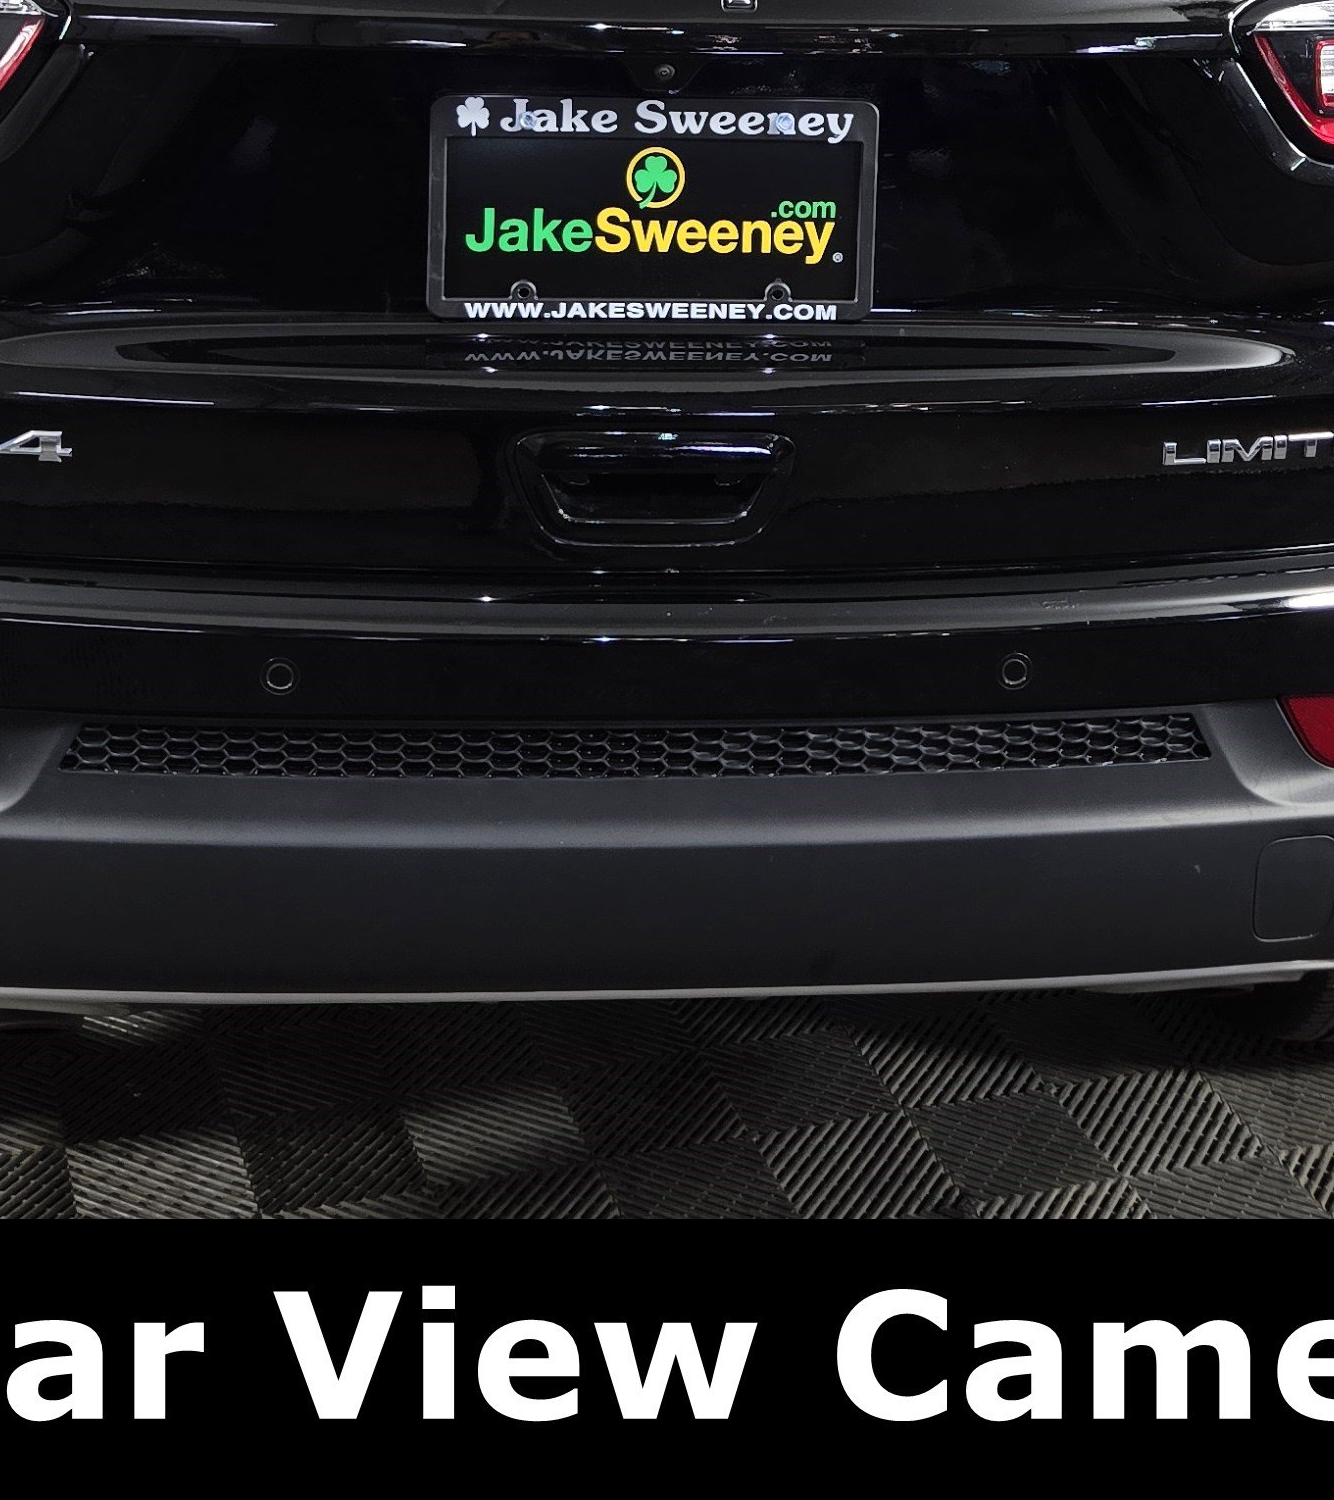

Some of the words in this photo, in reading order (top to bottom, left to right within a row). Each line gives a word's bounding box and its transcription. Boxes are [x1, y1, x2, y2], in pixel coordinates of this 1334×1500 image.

[500, 98, 618, 133] Jake
[633, 99, 855, 144] Sweeney
[463, 301, 838, 322] WWW.JAKESWEENEY.COM
